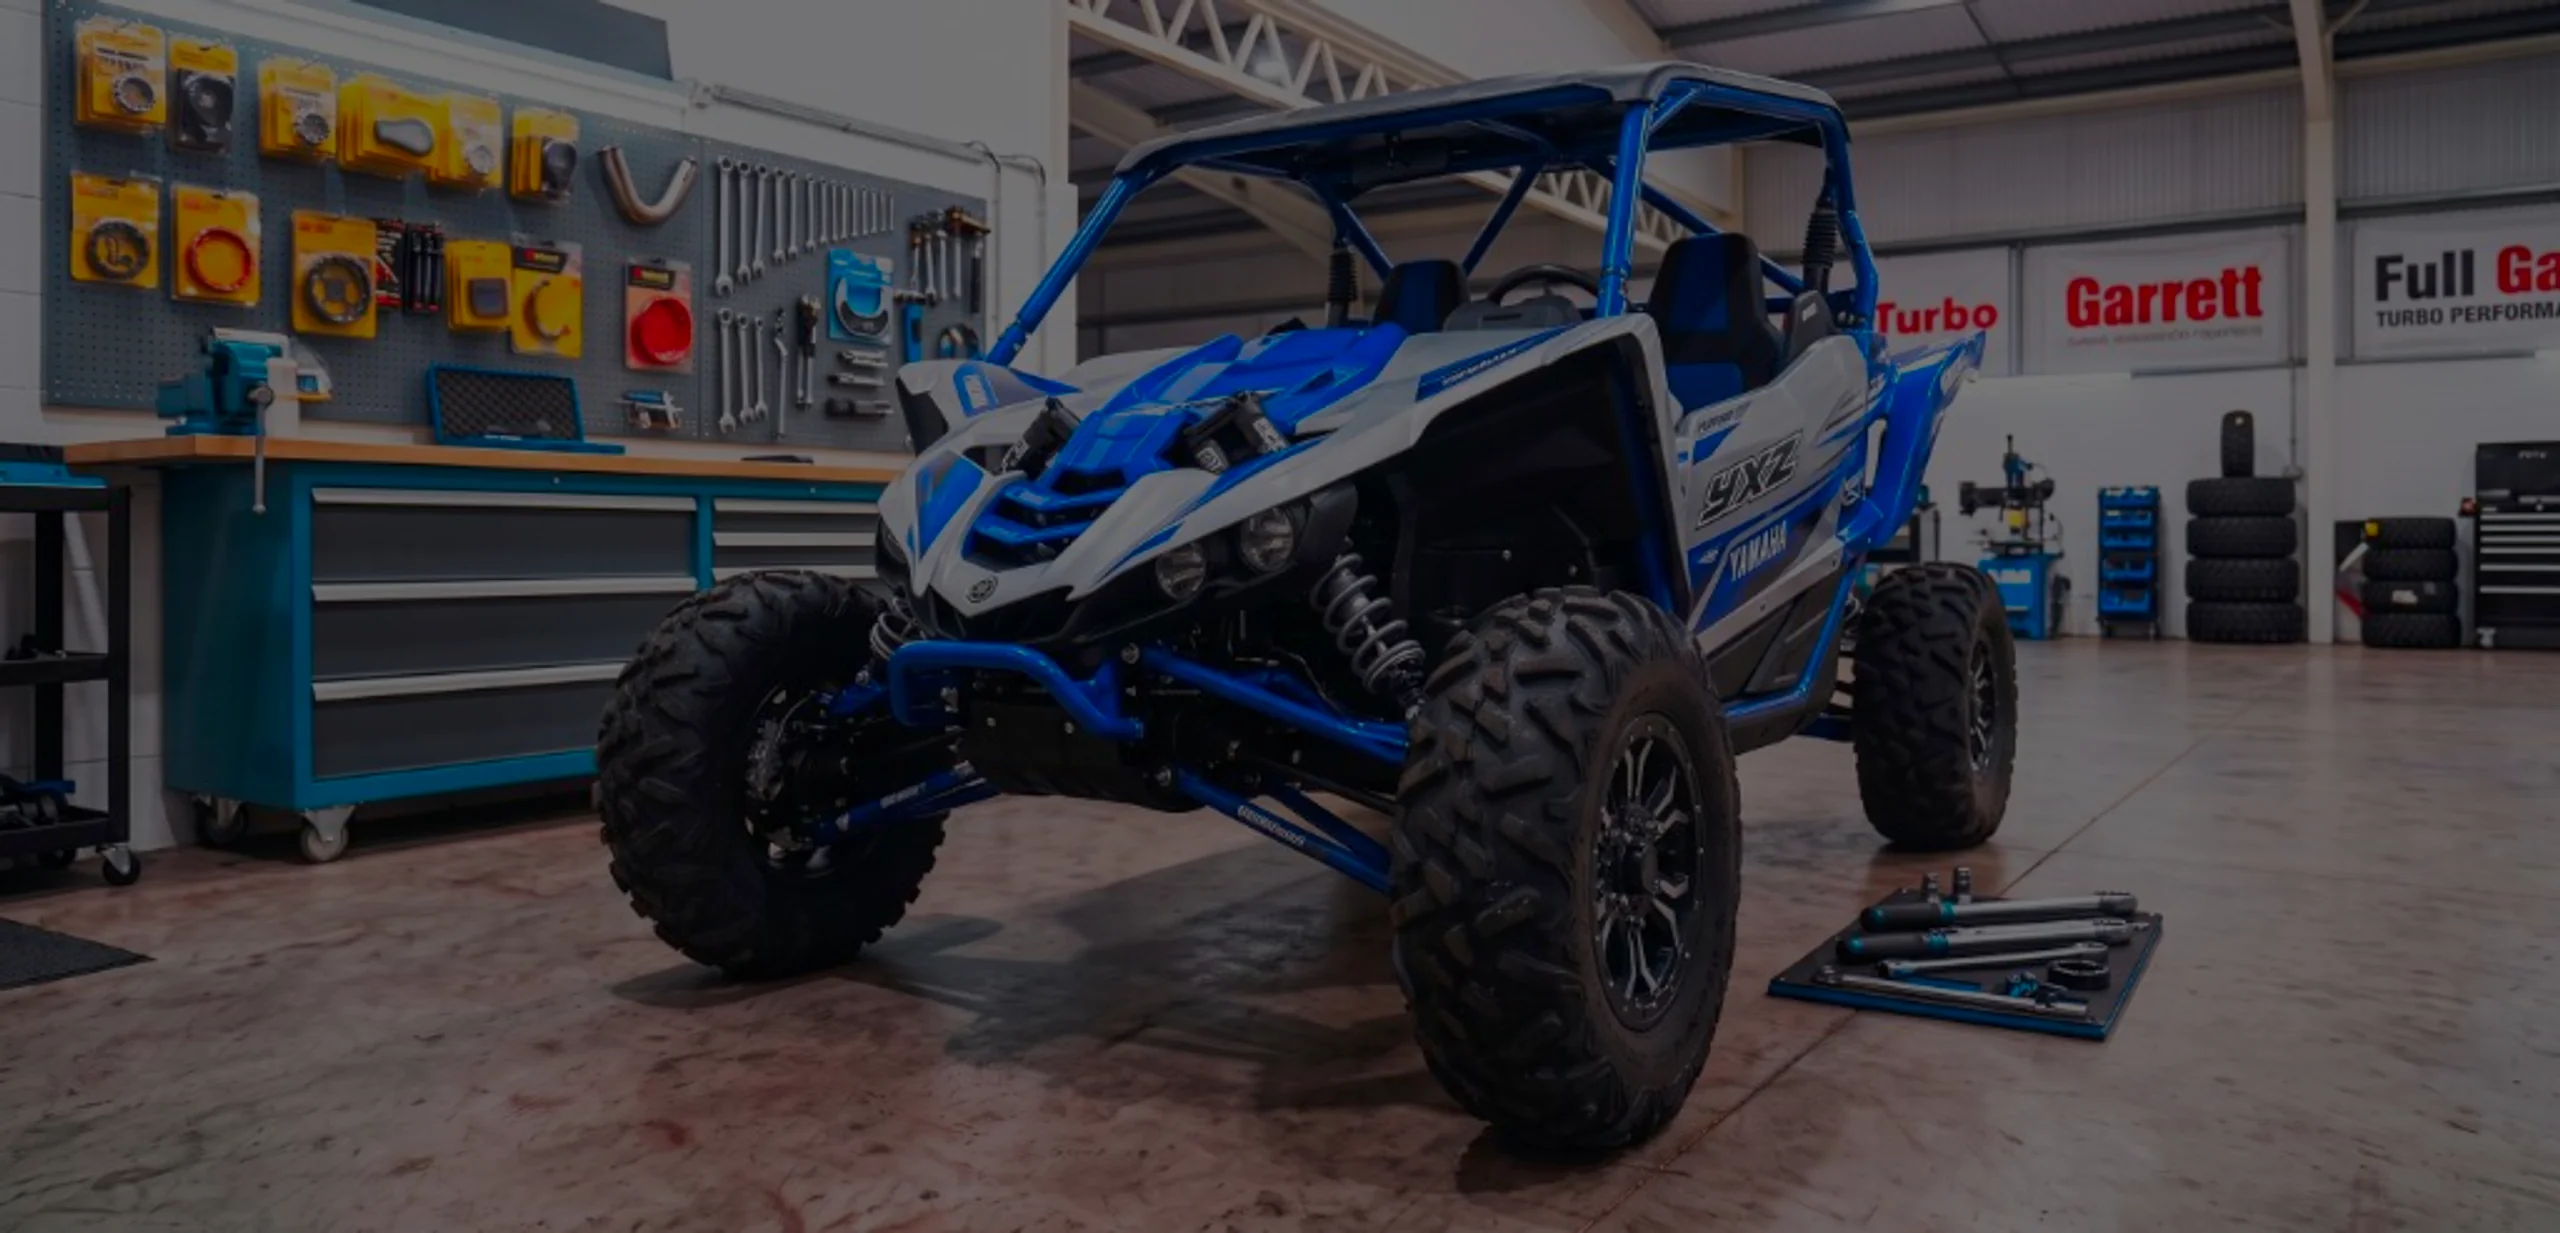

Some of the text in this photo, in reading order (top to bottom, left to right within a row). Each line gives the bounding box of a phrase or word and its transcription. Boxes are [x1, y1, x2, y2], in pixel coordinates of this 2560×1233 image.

[2066, 265, 2263, 328] Garrett
[2375, 249, 2475, 302] Full
[1876, 296, 1998, 334] Turbo
[2377, 308, 2444, 328] TURBO
[1695, 428, 1804, 531] YXZ
[1729, 519, 1787, 582] YAMAHA
